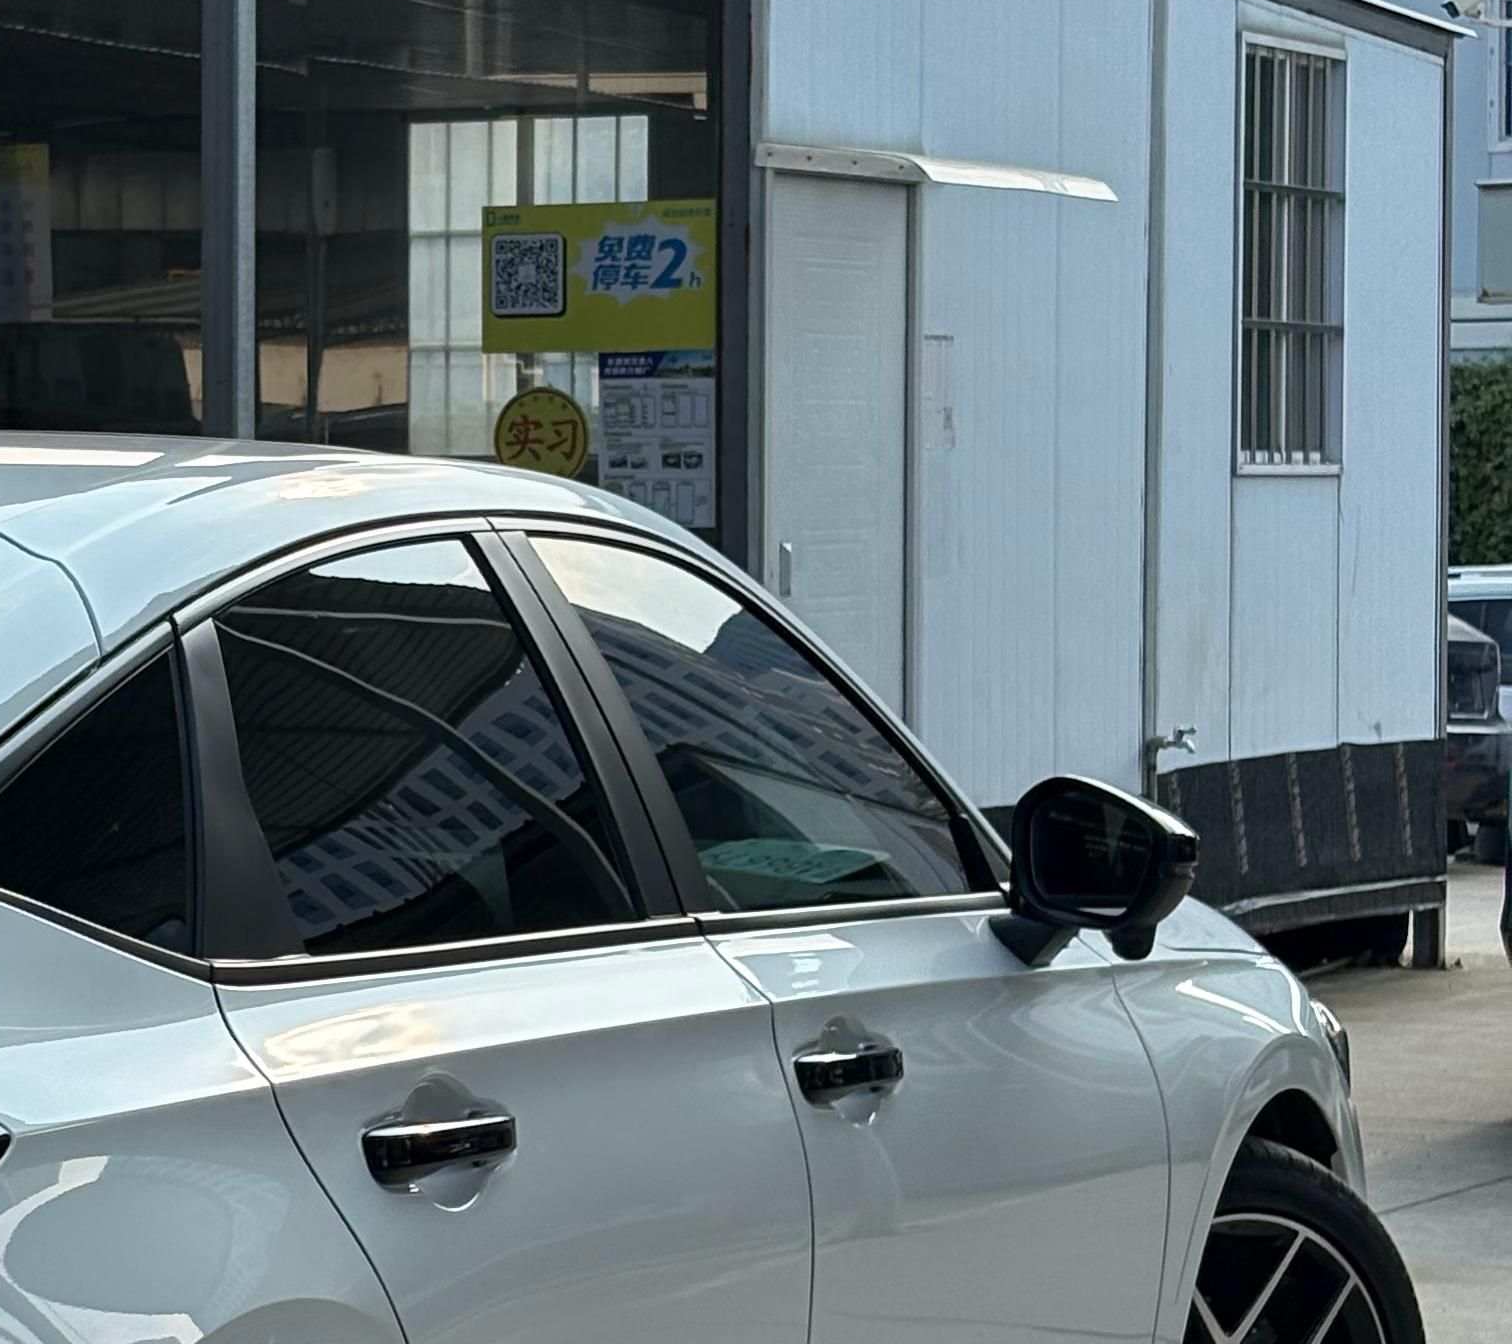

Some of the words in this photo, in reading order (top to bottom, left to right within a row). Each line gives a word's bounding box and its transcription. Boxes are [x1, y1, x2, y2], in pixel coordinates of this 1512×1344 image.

[594, 234, 656, 262] 免费
[592, 263, 652, 291] 停车
[505, 414, 580, 462] 实习
